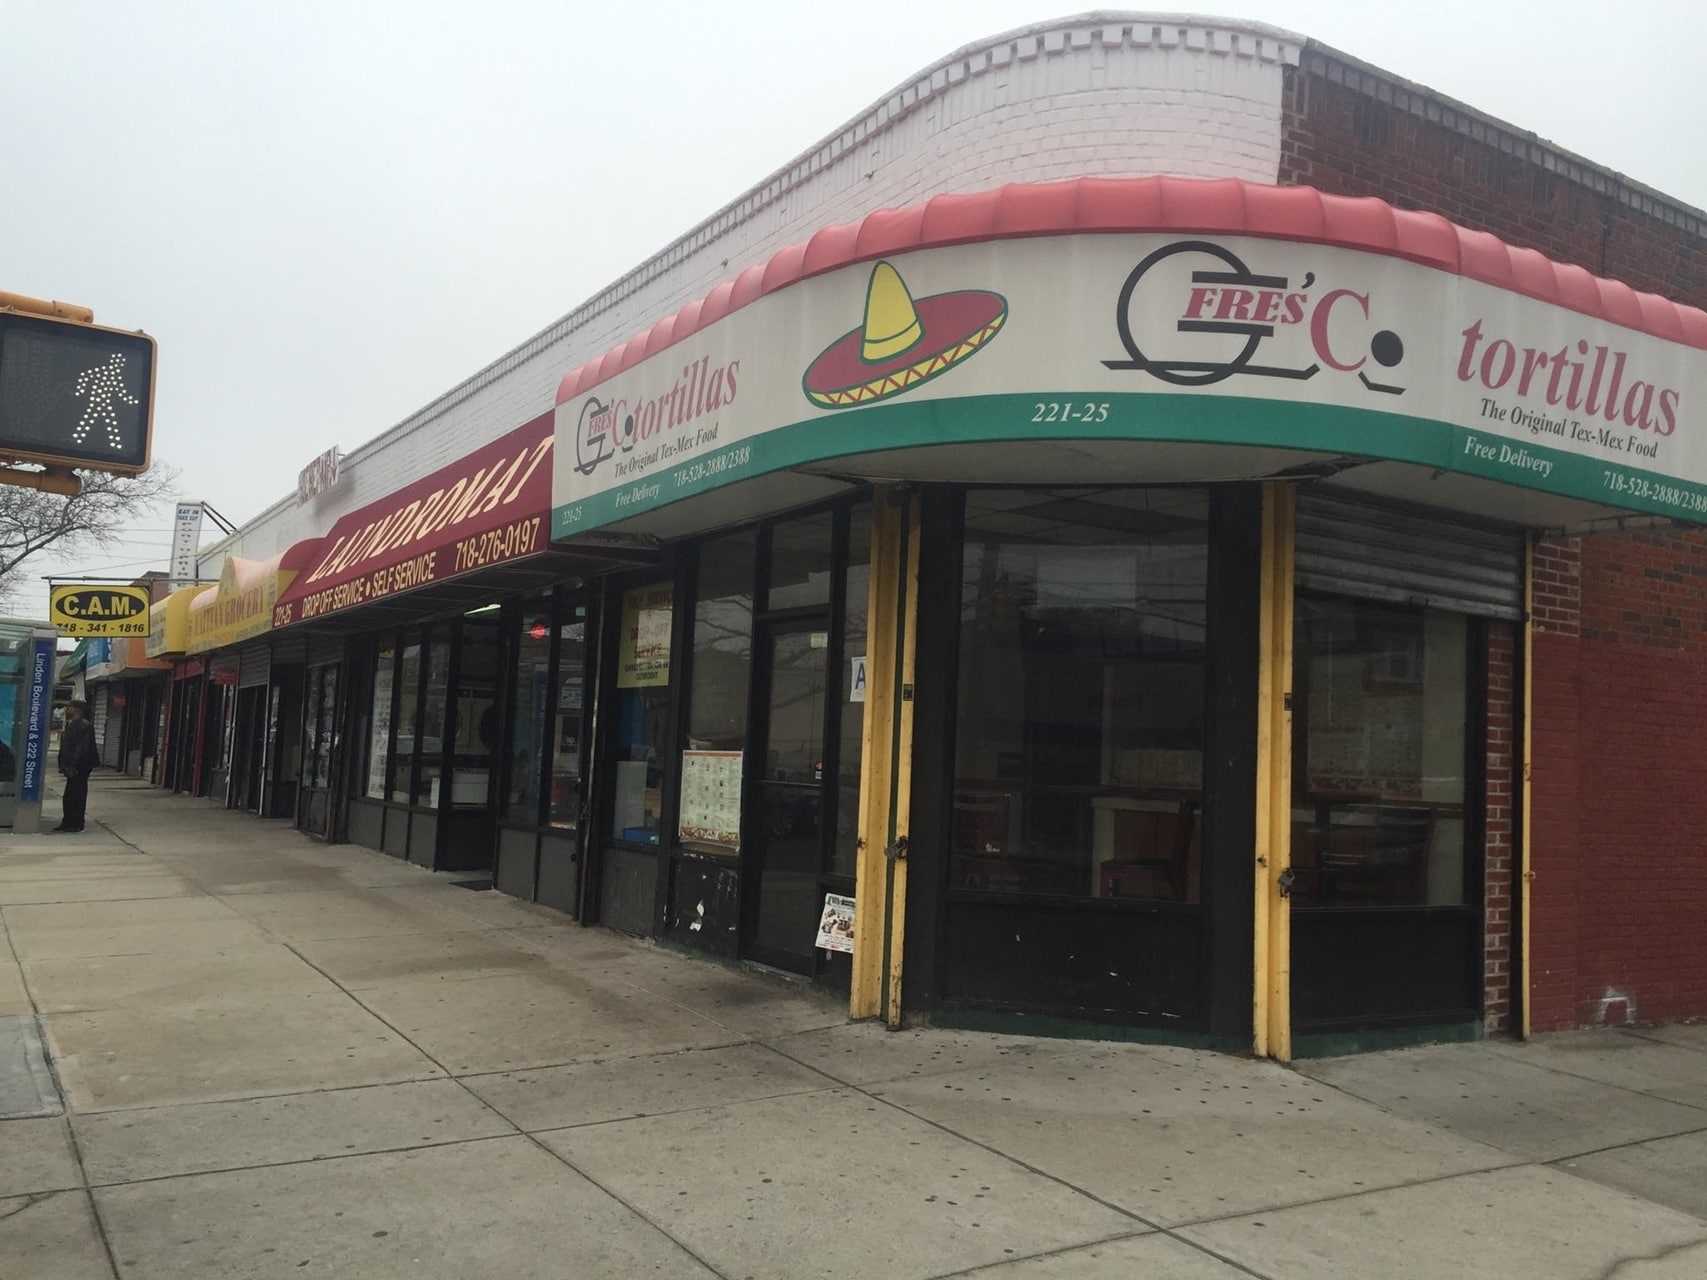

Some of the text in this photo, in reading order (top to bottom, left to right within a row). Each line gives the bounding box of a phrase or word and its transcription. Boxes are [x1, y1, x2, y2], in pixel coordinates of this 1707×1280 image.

[1457, 318, 1680, 437] tortillas
[633, 355, 740, 445] tortillas
[1031, 402, 1110, 423] 221-25
[1480, 397, 1659, 459] The Original Tex-Mex Food
[615, 421, 719, 479] The Original Tex-Mex Food
[673, 445, 751, 488] 718-528-2888/2388
[1464, 435, 1553, 478] Free Delivery
[305, 434, 554, 584] LAUNDROMAT
[615, 482, 661, 508] Free Delivery
[1603, 470, 1707, 513] 718-528-2888/2388
[562, 505, 582, 526] 221-25
[274, 603, 292, 627] 221-25
[301, 590, 320, 618] DROP
[319, 587, 333, 614] OFF
[332, 576, 365, 609] SERVICE
[372, 565, 393, 598] SELF
[394, 551, 437, 591] SERVICE
[455, 516, 541, 572] 718-276-0197
[63, 595, 137, 616] C.A.M.
[87, 623, 107, 633] 341
[119, 623, 145, 633] 1816
[34, 652, 47, 684] Linden
[854, 661, 866, 690] A
[29, 685, 43, 731] Boulevard
[26, 742, 38, 759] 222
[23, 760, 36, 788] Street
